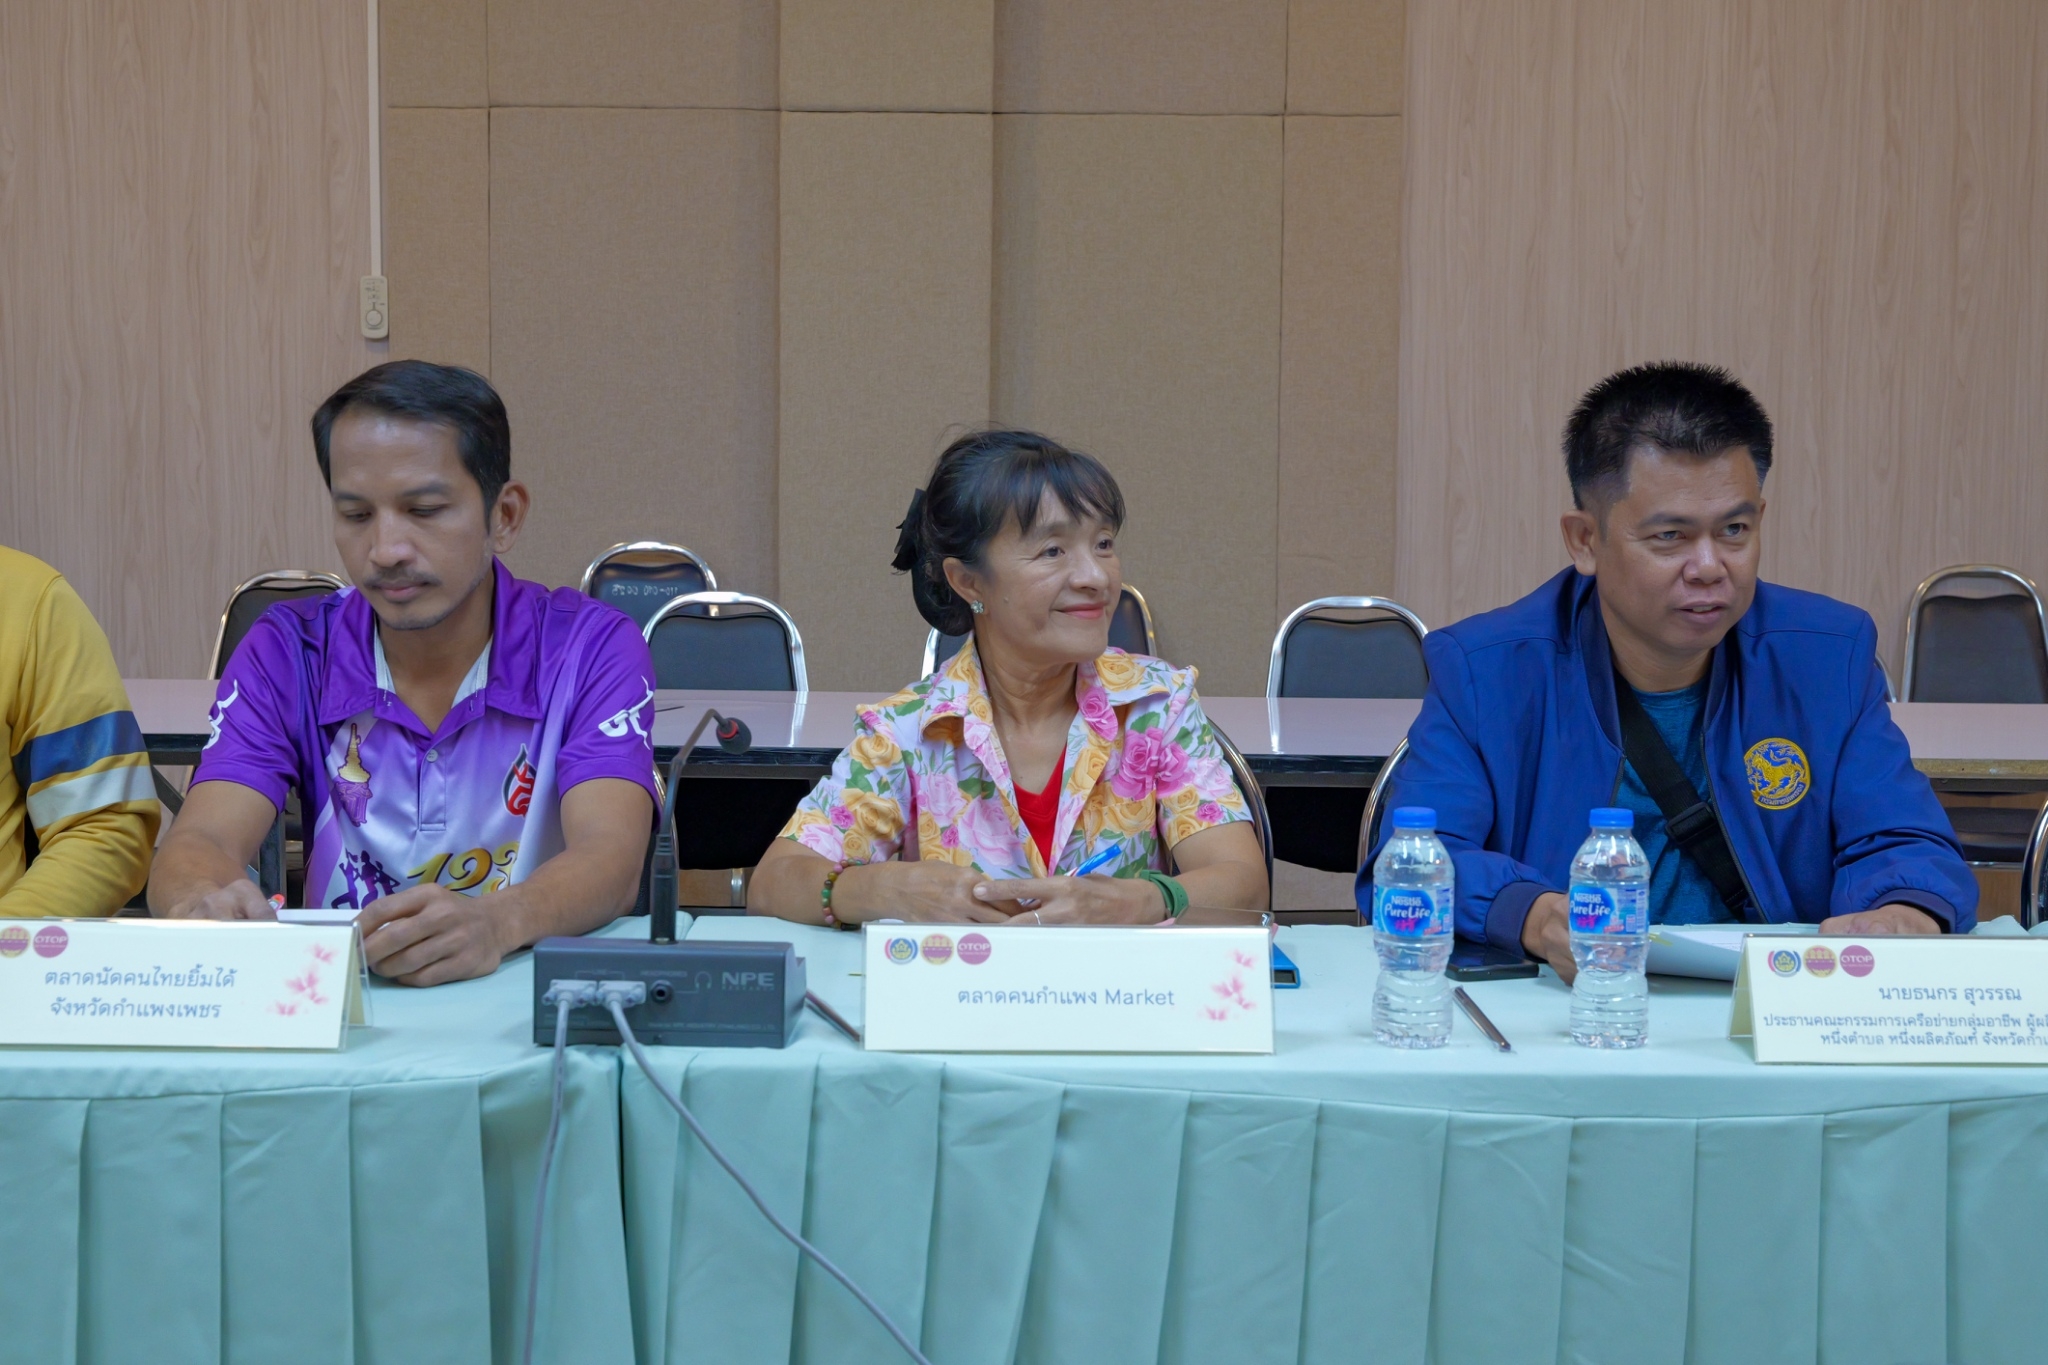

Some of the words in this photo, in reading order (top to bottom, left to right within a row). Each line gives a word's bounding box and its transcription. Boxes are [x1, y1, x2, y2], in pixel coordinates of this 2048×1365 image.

[34, 935, 68, 944] OTOP
[958, 942, 991, 951] OTOP
[1840, 954, 1873, 964] OTOP
[44, 963, 237, 988] ตลาดนัดคนไทยยิ้มได้
[721, 972, 775, 986] NPE
[957, 985, 1098, 1006] ตลาดคนกำแพง
[1104, 988, 1175, 1007] Market
[1878, 986, 1958, 1002] นายธนกร
[1964, 986, 2022, 1006] สุวรรณ
[50, 996, 222, 1019] จังหวัดกำแพงเพชร
